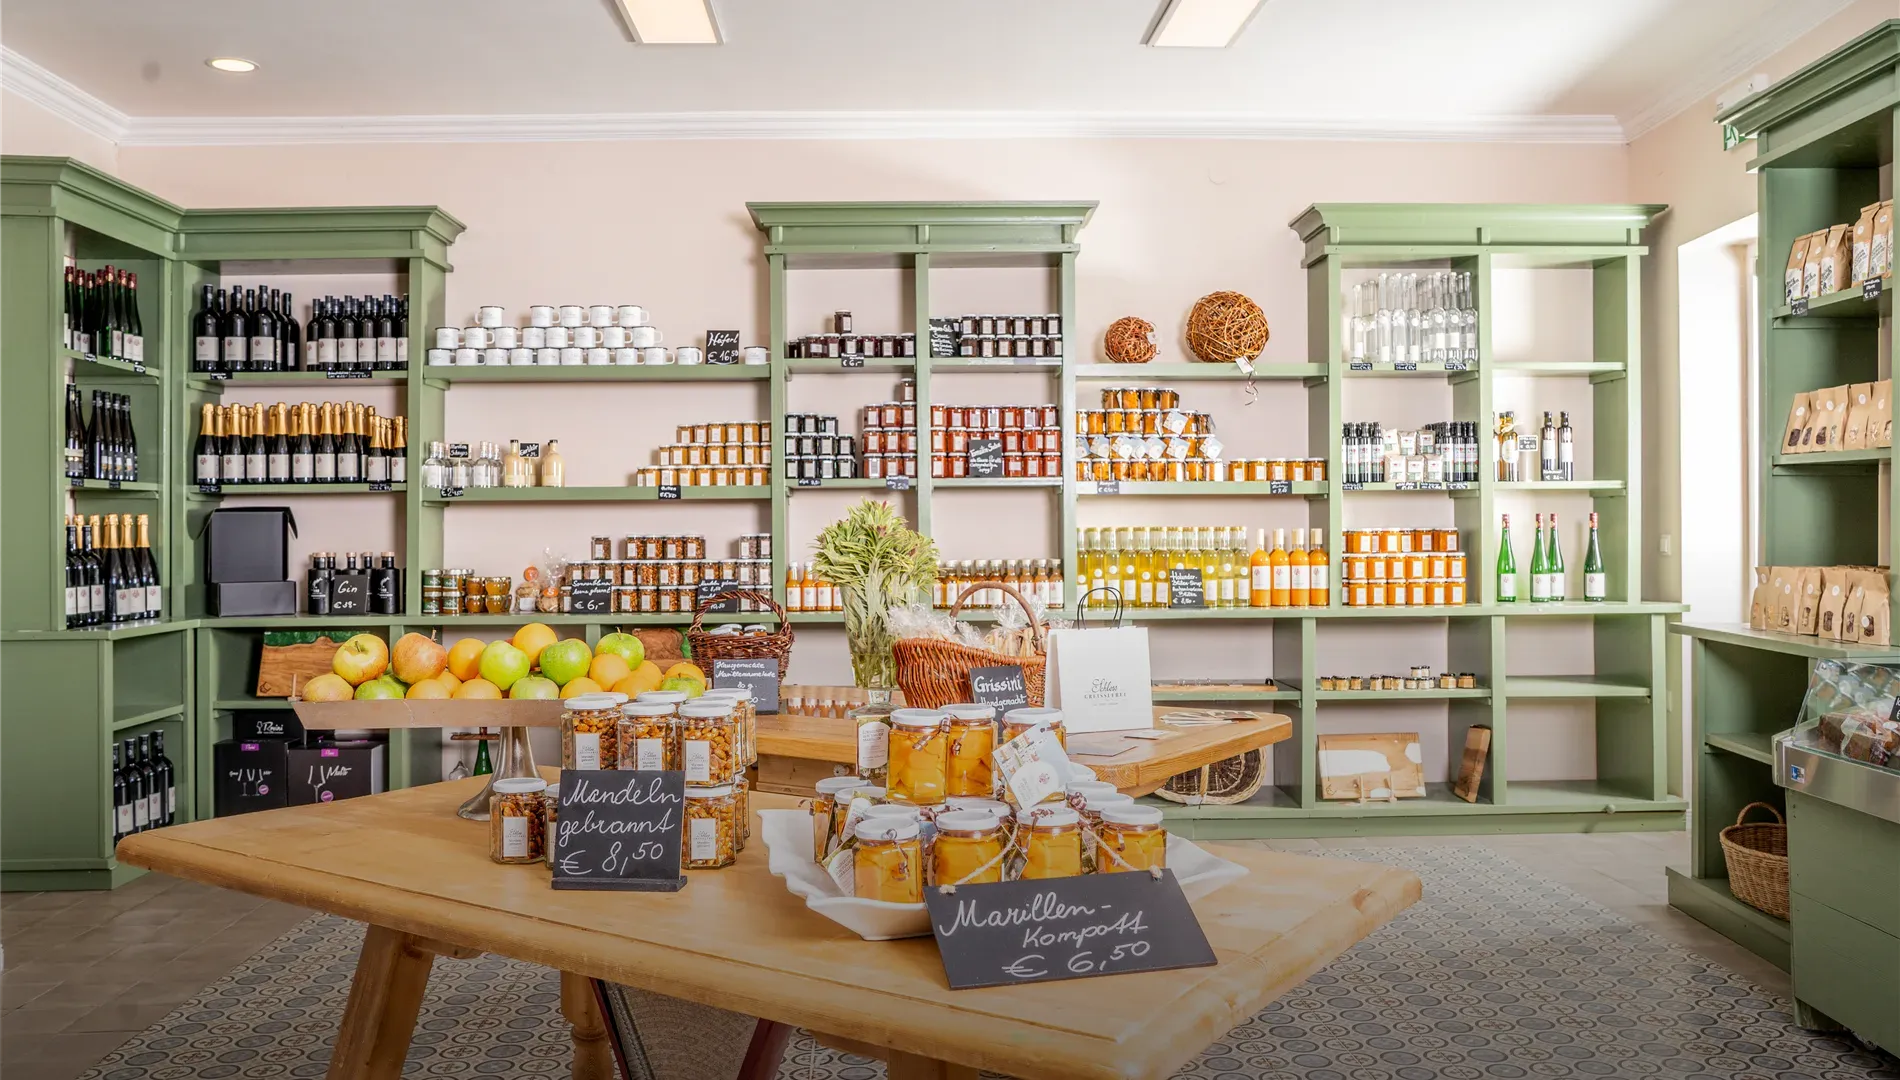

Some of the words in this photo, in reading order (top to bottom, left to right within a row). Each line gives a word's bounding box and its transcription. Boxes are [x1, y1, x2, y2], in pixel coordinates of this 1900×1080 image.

[708, 332, 739, 347] Häferl
[337, 580, 358, 594] Gin
[574, 600, 584, 609] €
[973, 674, 1023, 693] Grissini
[563, 777, 681, 806] Mandeln
[559, 808, 675, 847] gebrannt
[559, 850, 593, 875] €
[602, 841, 664, 875] 8,50
[940, 892, 1111, 936] Marillen-
[1022, 911, 1148, 948] Kompott
[1002, 954, 1048, 978] €
[1067, 941, 1150, 973] 6,50
